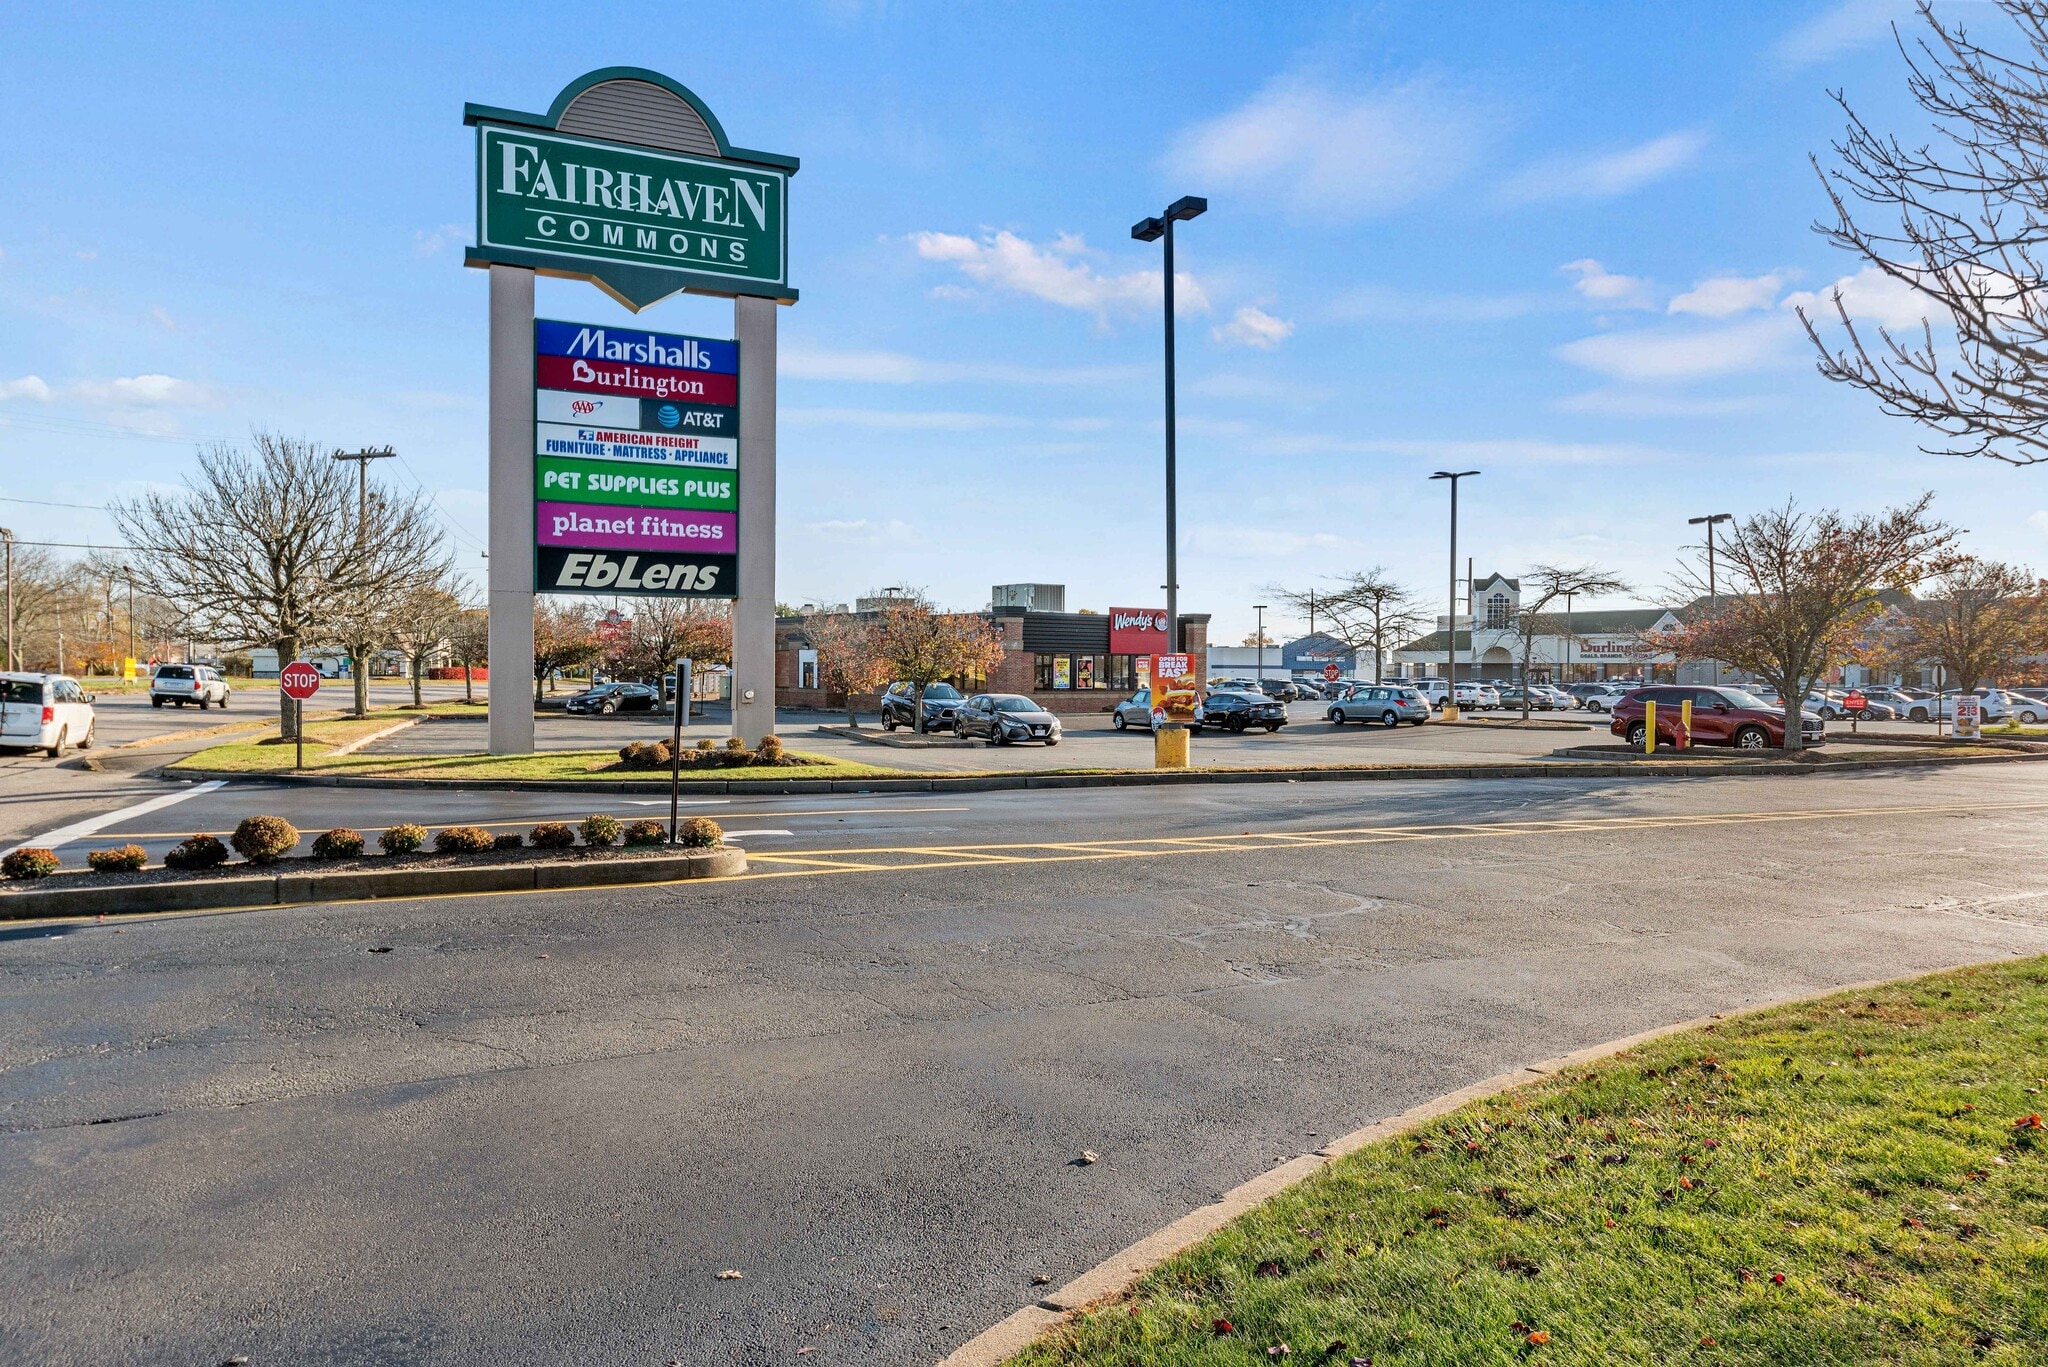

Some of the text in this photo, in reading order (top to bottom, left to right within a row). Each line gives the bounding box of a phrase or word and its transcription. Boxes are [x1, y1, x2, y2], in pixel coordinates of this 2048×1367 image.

[496, 141, 770, 232] FAIRHAVEN
[536, 215, 746, 263] COMMONS
[566, 327, 711, 370] Marshalls
[572, 359, 705, 398] Burlington
[572, 400, 594, 414] AAA
[682, 411, 724, 428] AT&T
[595, 431, 653, 446] AMERICAN
[655, 436, 700, 449] FREIGHT
[545, 439, 729, 465] FURNITURE MATTRESS APPLIANCE
[544, 470, 731, 499] PET SUPPLIES PLUS
[552, 511, 724, 539] planet fitness
[555, 553, 720, 591] EbLens
[1113, 610, 1153, 632] Wendy's
[1158, 661, 1188, 669] BREAK
[1158, 668, 1188, 678] FAST
[1325, 669, 1339, 677] STOP
[283, 673, 318, 688] STOP
[1957, 706, 1967, 716] 2
